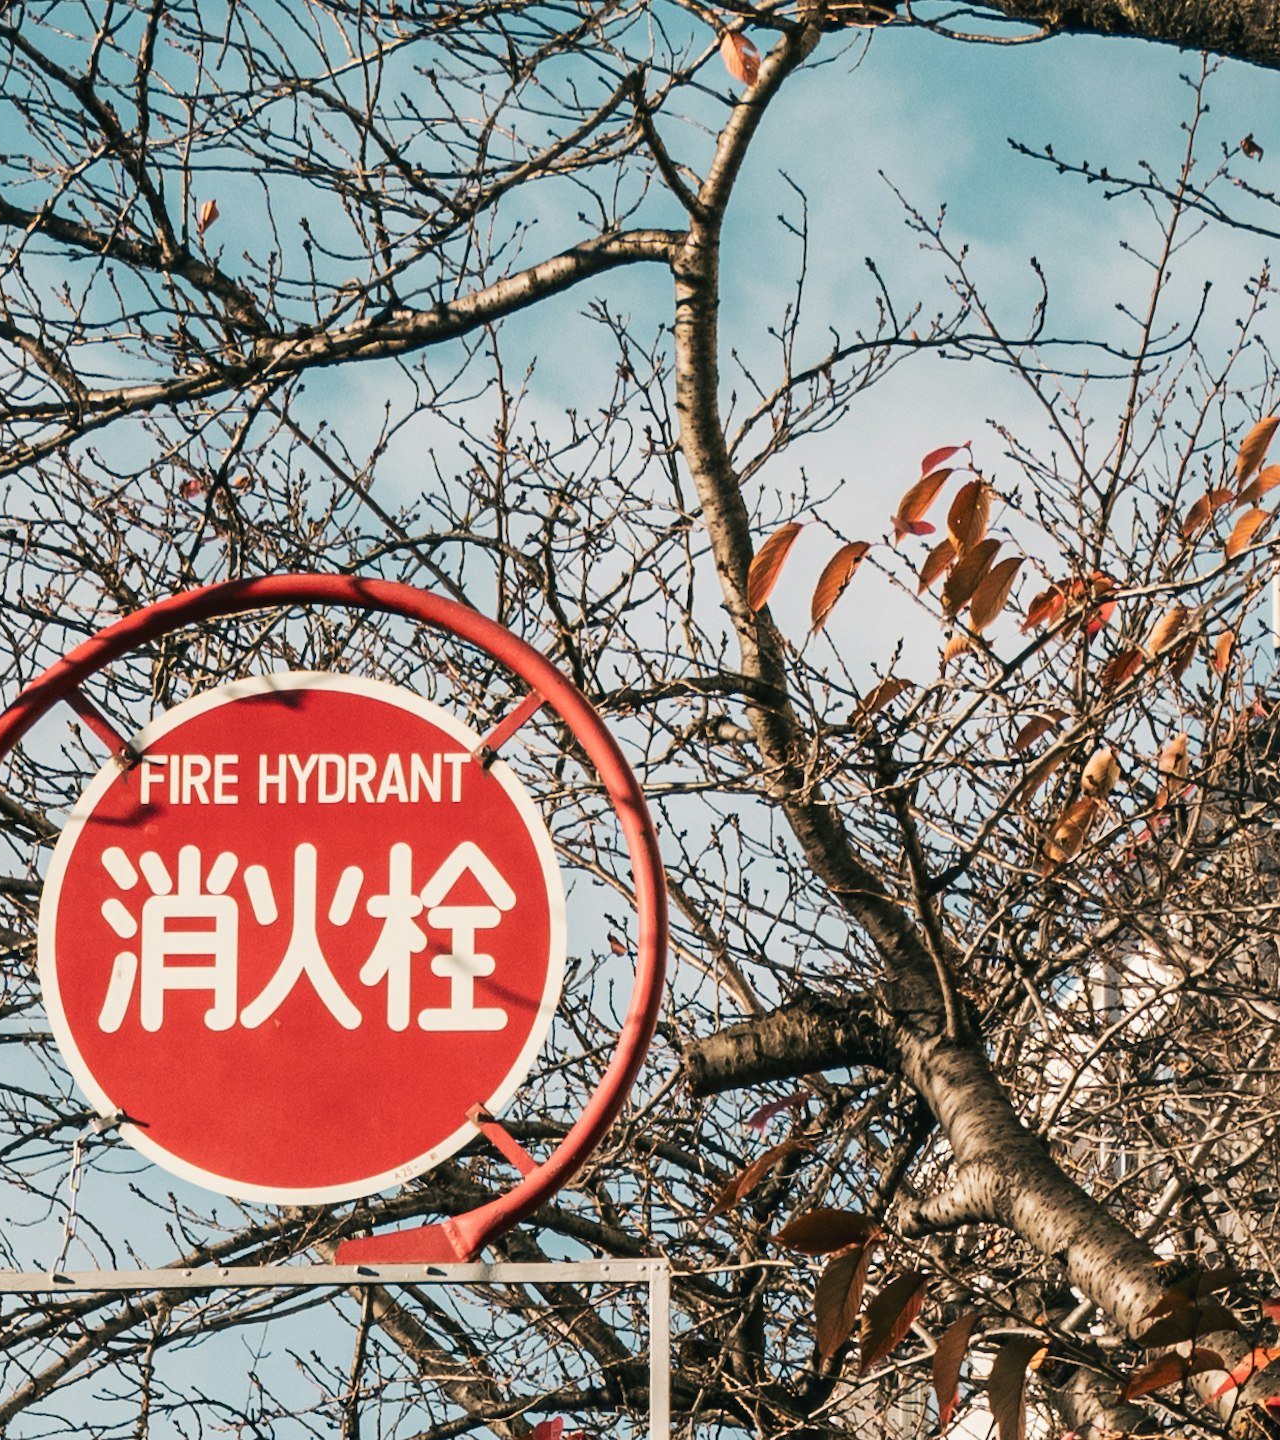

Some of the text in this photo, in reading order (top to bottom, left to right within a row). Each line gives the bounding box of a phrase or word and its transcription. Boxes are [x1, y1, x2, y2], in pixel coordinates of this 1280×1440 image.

[140, 751, 472, 805] FIRE HYDRANT
[98, 840, 517, 1033] 消火栓
